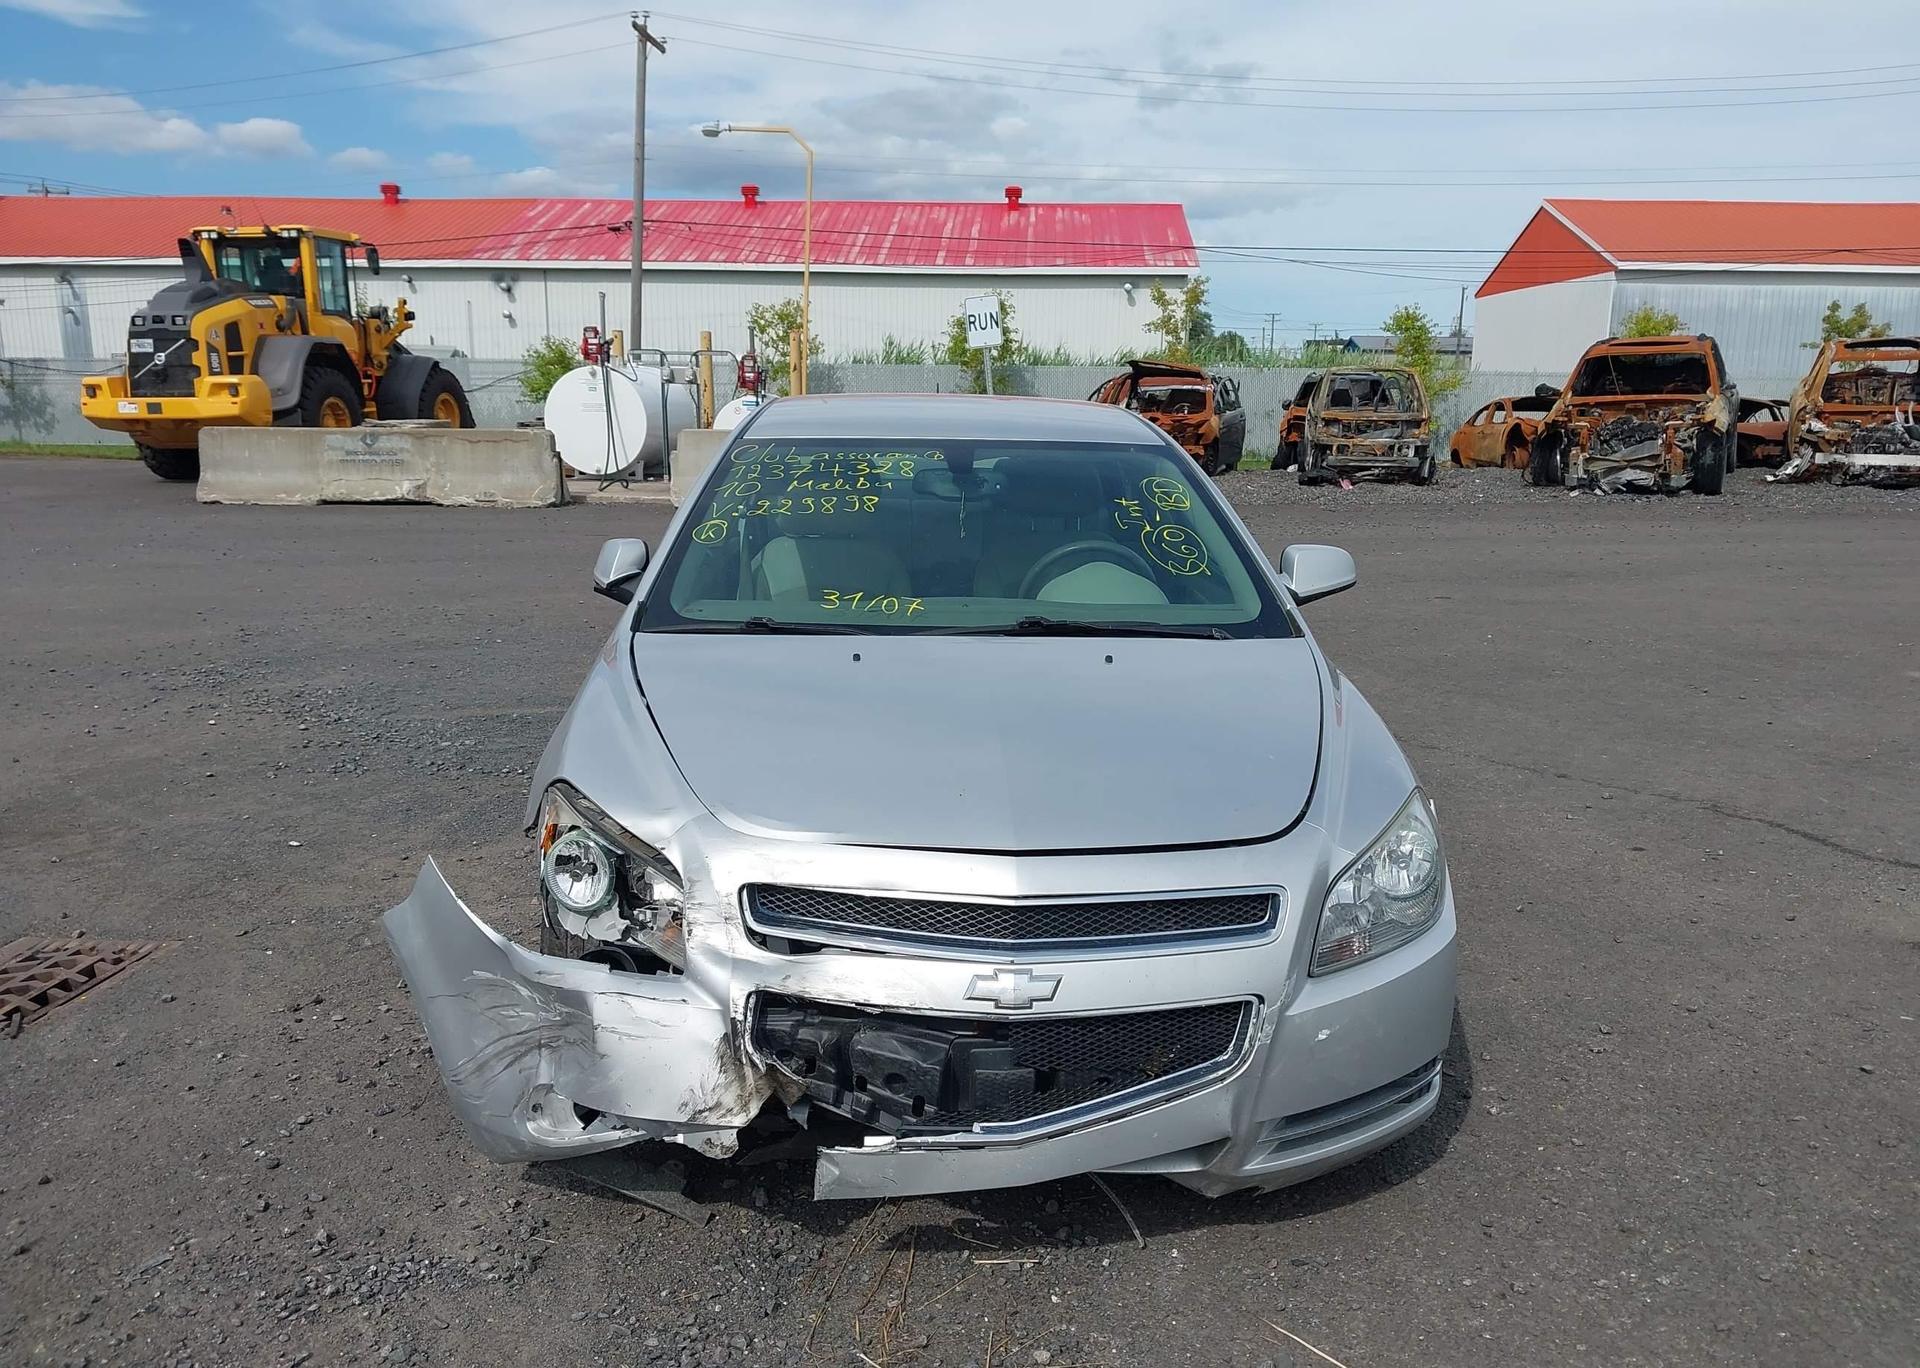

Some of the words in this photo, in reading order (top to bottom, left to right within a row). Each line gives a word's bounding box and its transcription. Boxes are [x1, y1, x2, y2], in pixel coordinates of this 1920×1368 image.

[968, 311, 999, 332] RUN
[731, 443, 801, 463] Club
[730, 461, 915, 480] 12374328
[714, 481, 762, 498] 10
[787, 477, 893, 492] Malibu
[820, 589, 925, 617] 31/07
